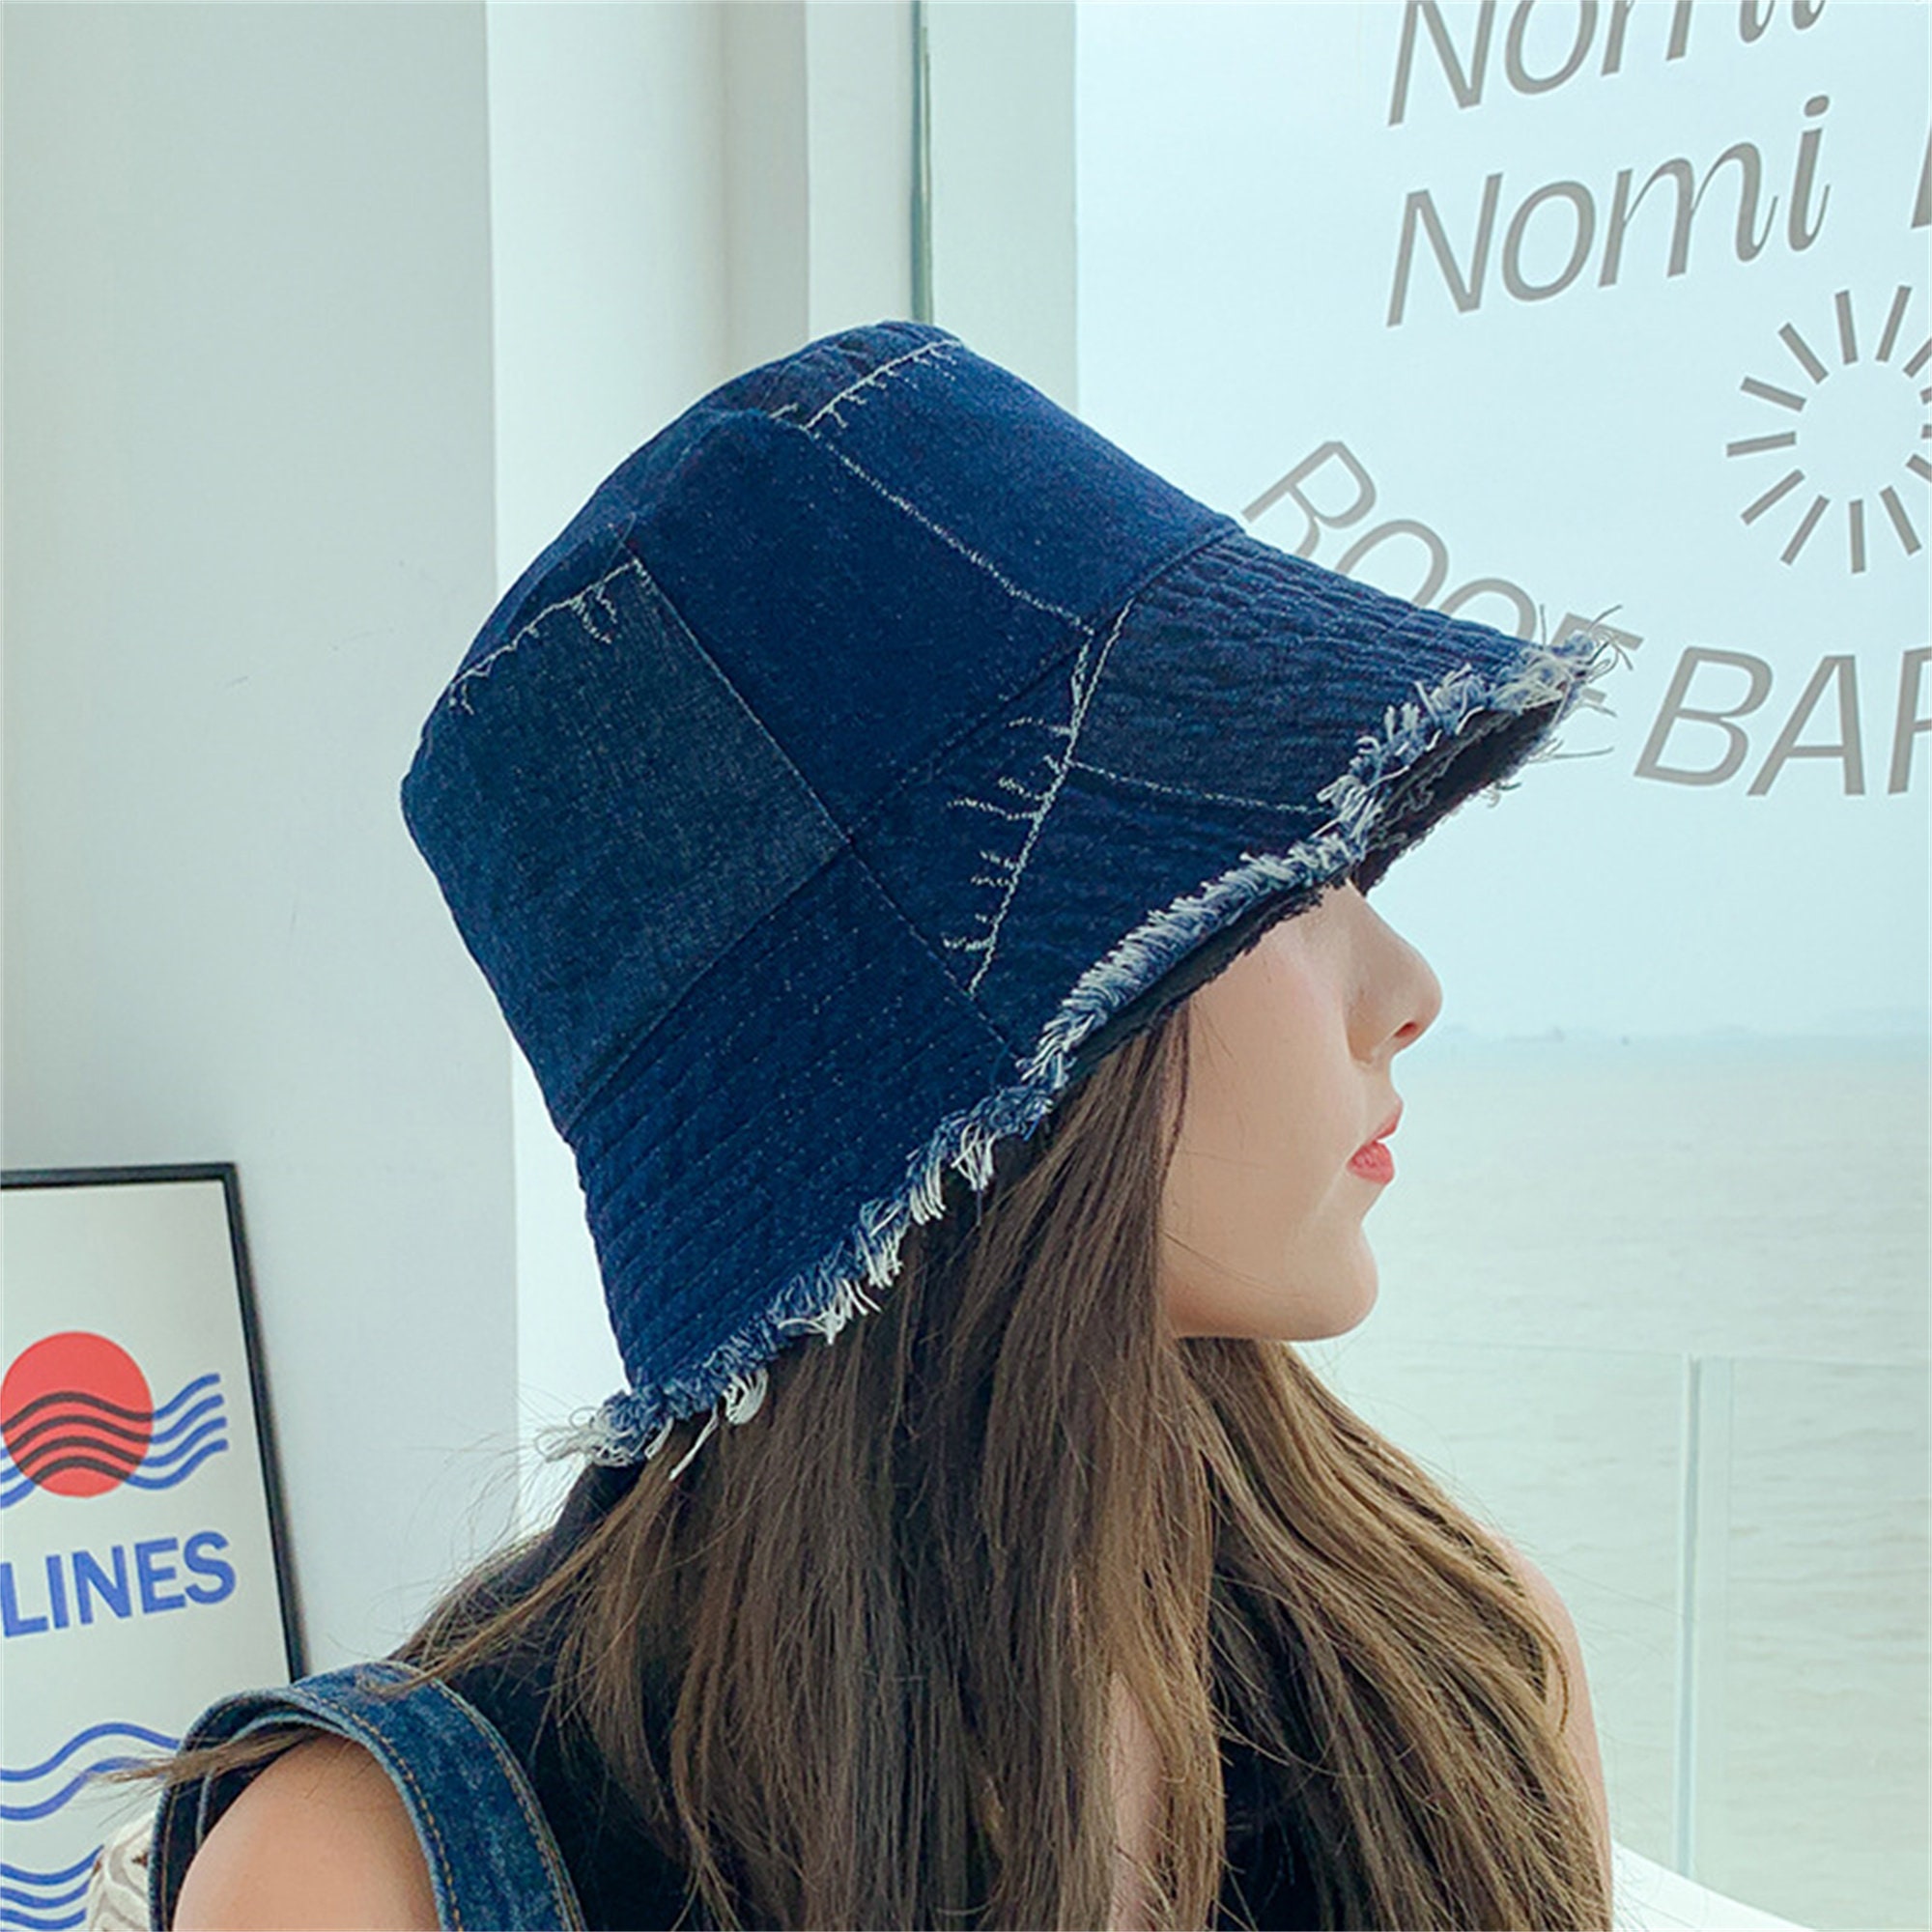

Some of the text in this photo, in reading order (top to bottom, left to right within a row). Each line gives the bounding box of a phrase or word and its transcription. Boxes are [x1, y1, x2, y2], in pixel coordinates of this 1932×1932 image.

[1388, 0, 1826, 126] No
[1386, 94, 1831, 327] Nomi
[0, 1531, 237, 1638] LINES
